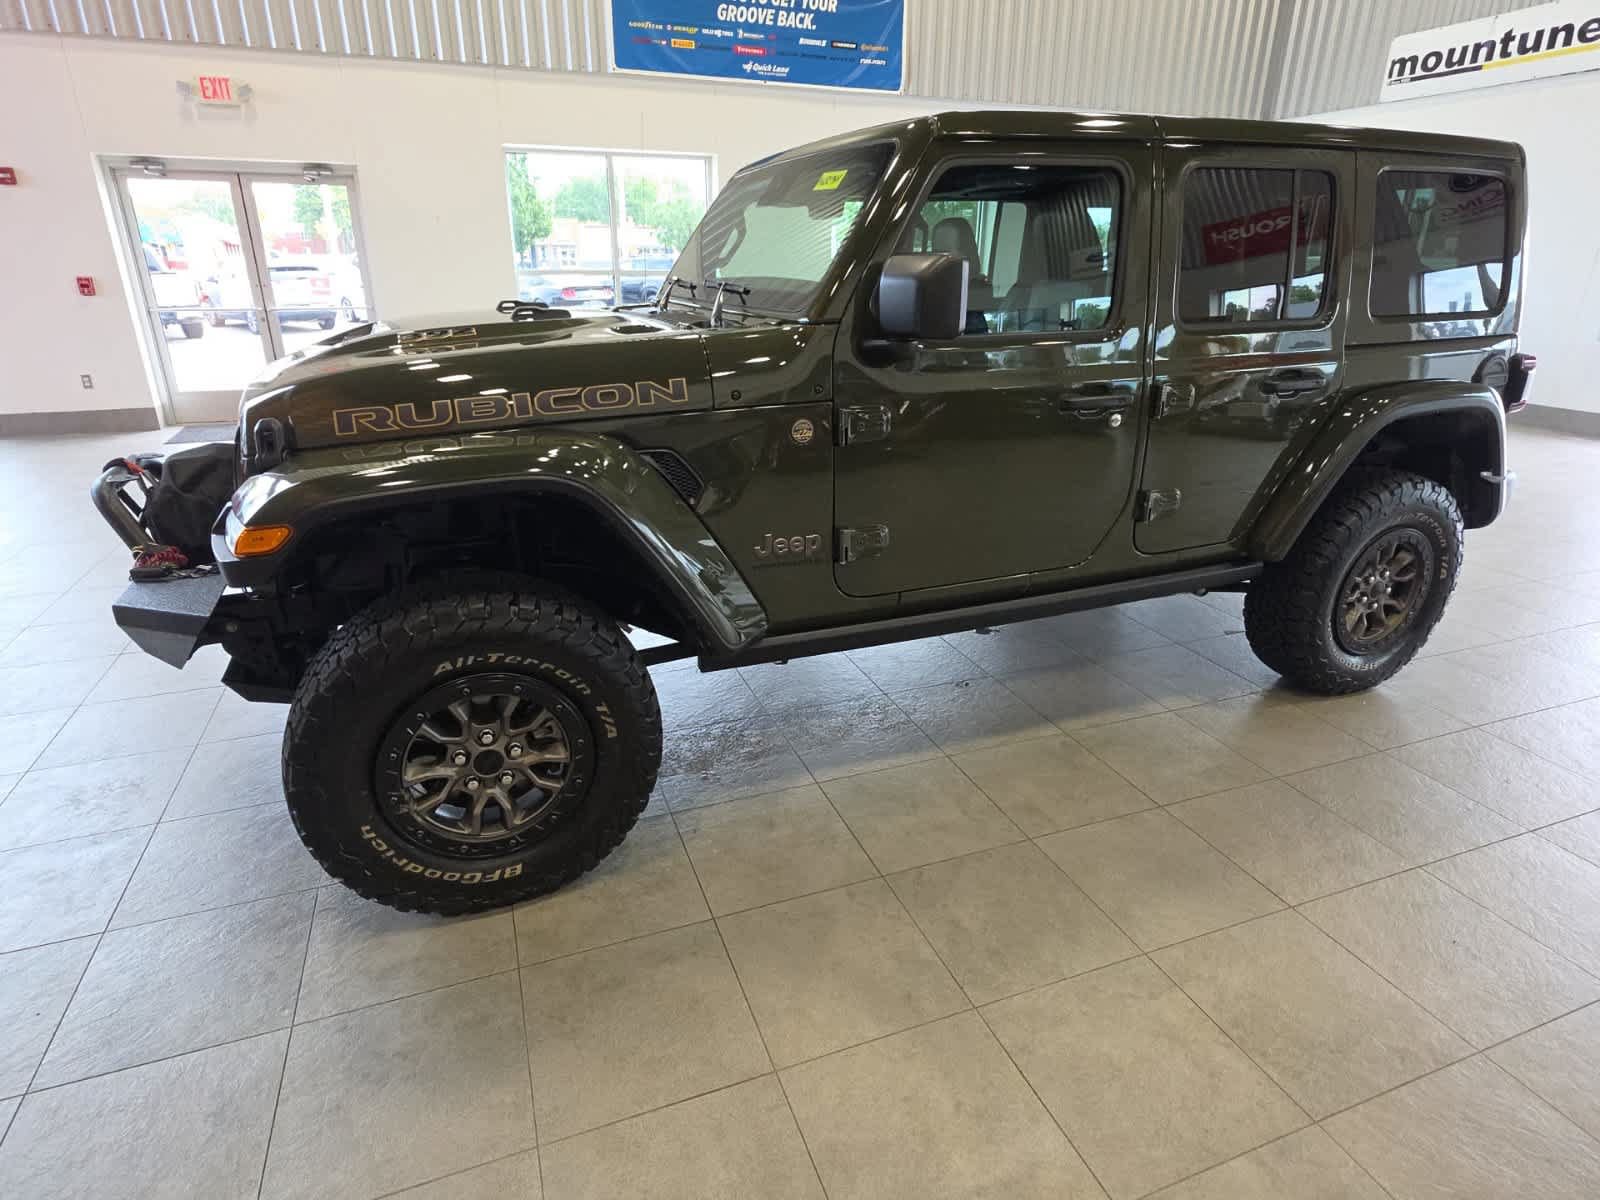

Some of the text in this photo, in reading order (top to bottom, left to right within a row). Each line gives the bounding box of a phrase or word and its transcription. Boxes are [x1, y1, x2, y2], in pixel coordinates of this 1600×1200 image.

[717, 3, 817, 30] GROOVE BACK.
[1388, 16, 1600, 80] mountune
[200, 77, 232, 101] EXIT
[332, 378, 689, 436] RUBICON
[752, 532, 823, 559] Jeep
[433, 652, 592, 696] All-Terrain
[360, 823, 524, 885] BFGoodrich
